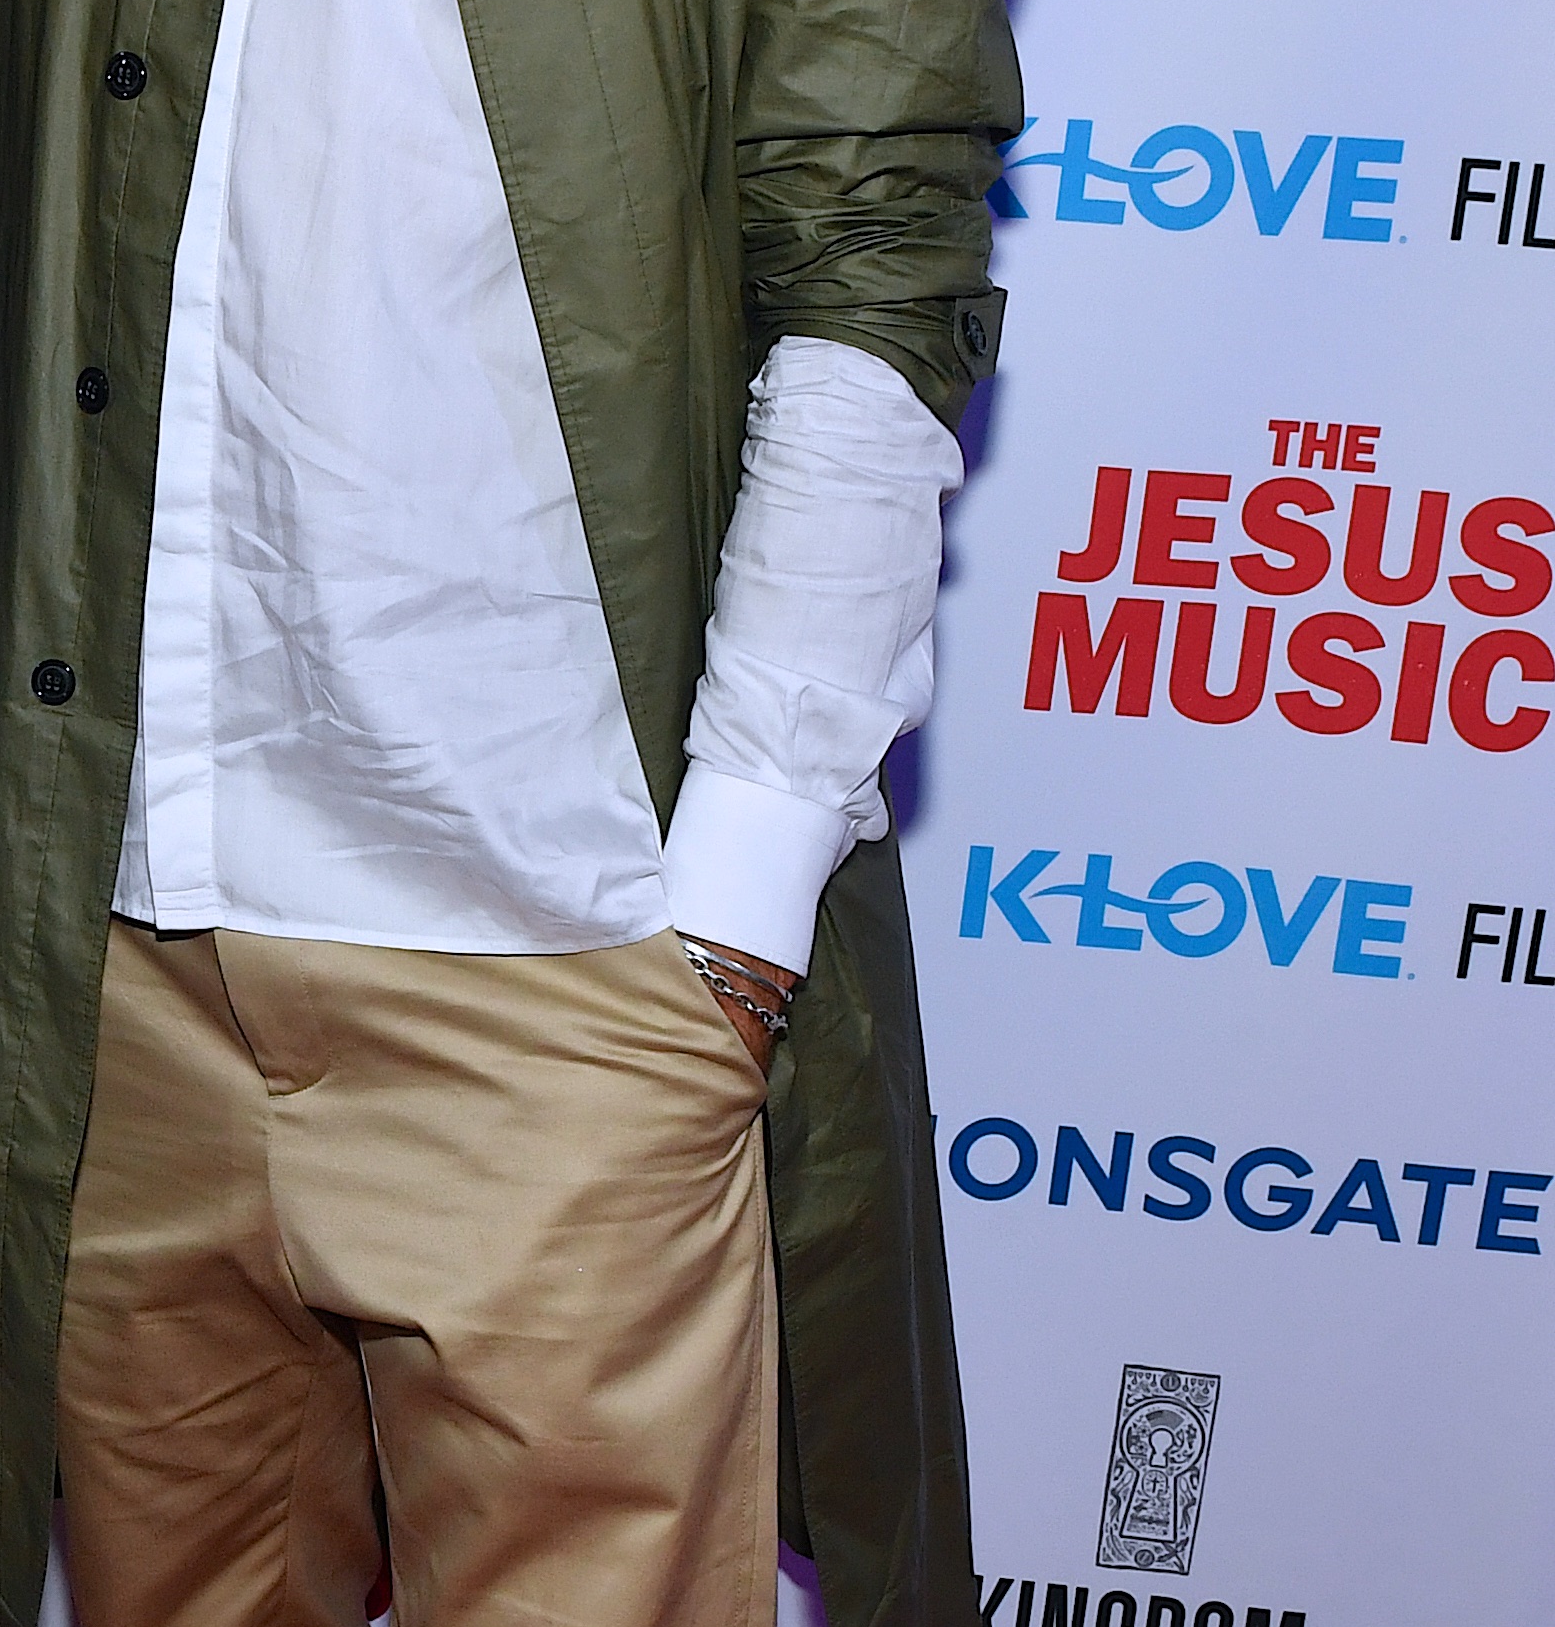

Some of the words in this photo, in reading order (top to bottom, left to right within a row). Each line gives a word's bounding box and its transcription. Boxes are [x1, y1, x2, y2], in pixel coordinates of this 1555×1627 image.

[1268, 420, 1381, 473] THE
[1057, 466, 1555, 617] JESUS
[1024, 591, 1555, 752] MUSIC
[930, 1115, 1554, 1256] ONSGATE
